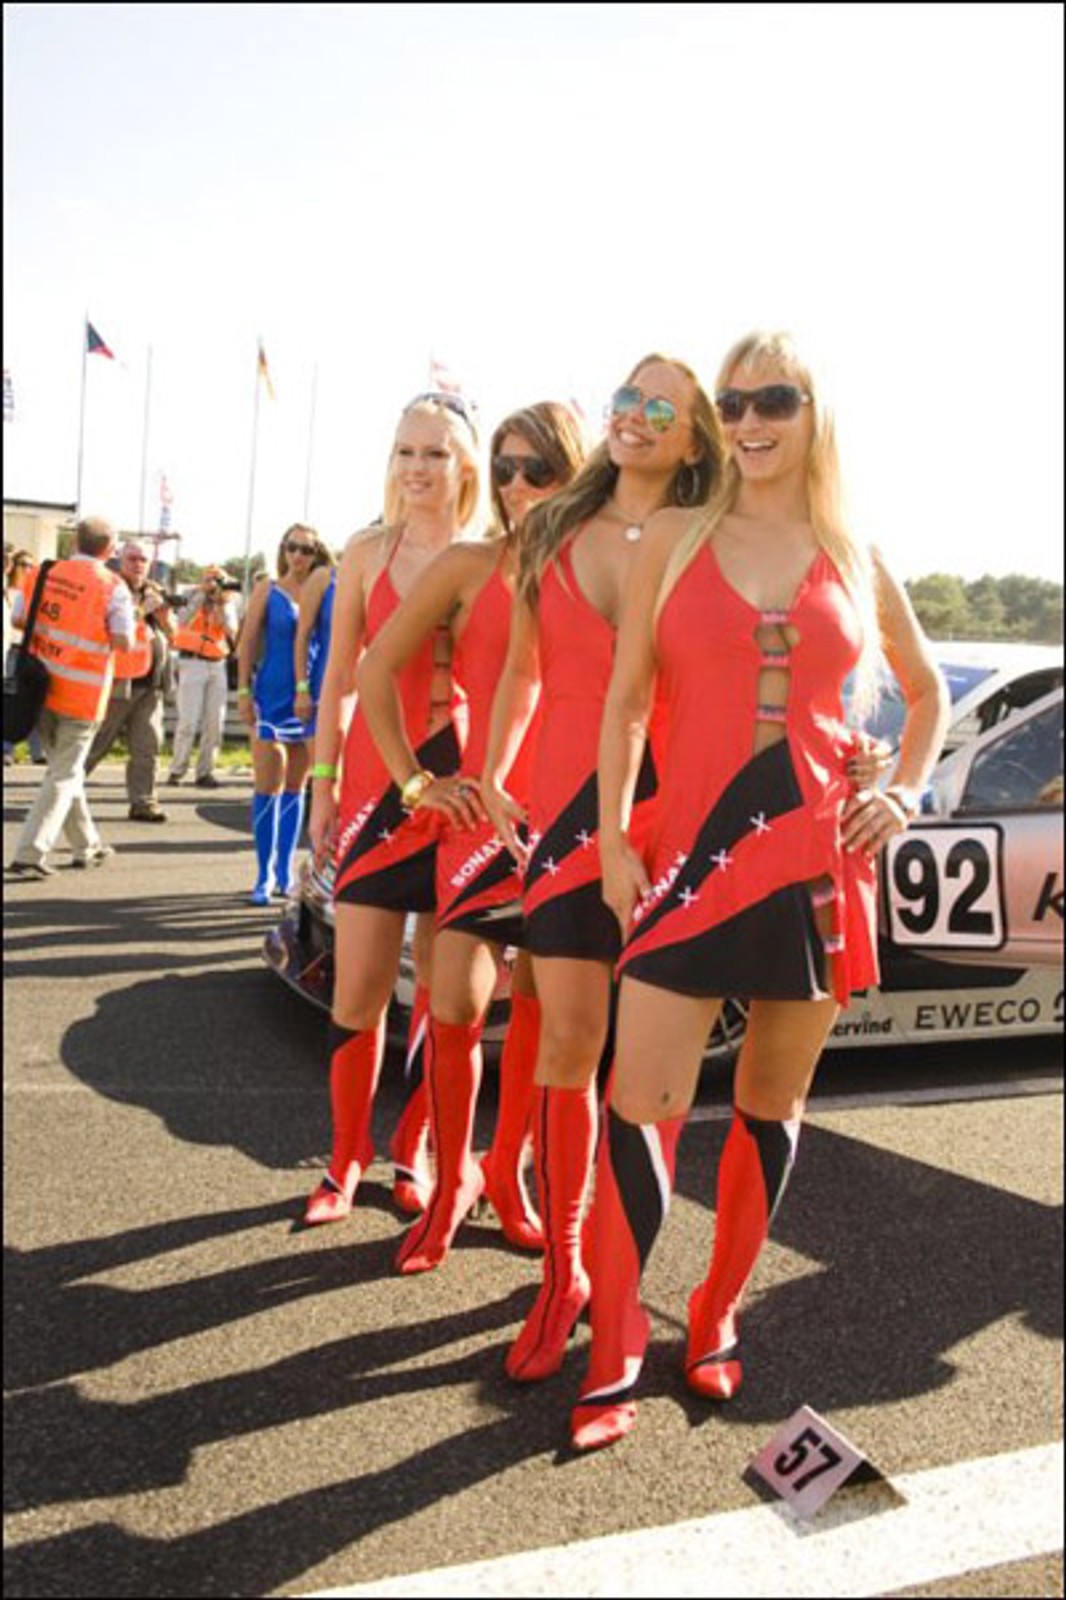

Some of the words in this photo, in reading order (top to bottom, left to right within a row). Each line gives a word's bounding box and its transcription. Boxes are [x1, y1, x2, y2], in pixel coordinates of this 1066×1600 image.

[451, 834, 506, 887] SONAX
[894, 838, 994, 934] 92
[914, 998, 1040, 1030] EWECO
[774, 1428, 842, 1492] 57
